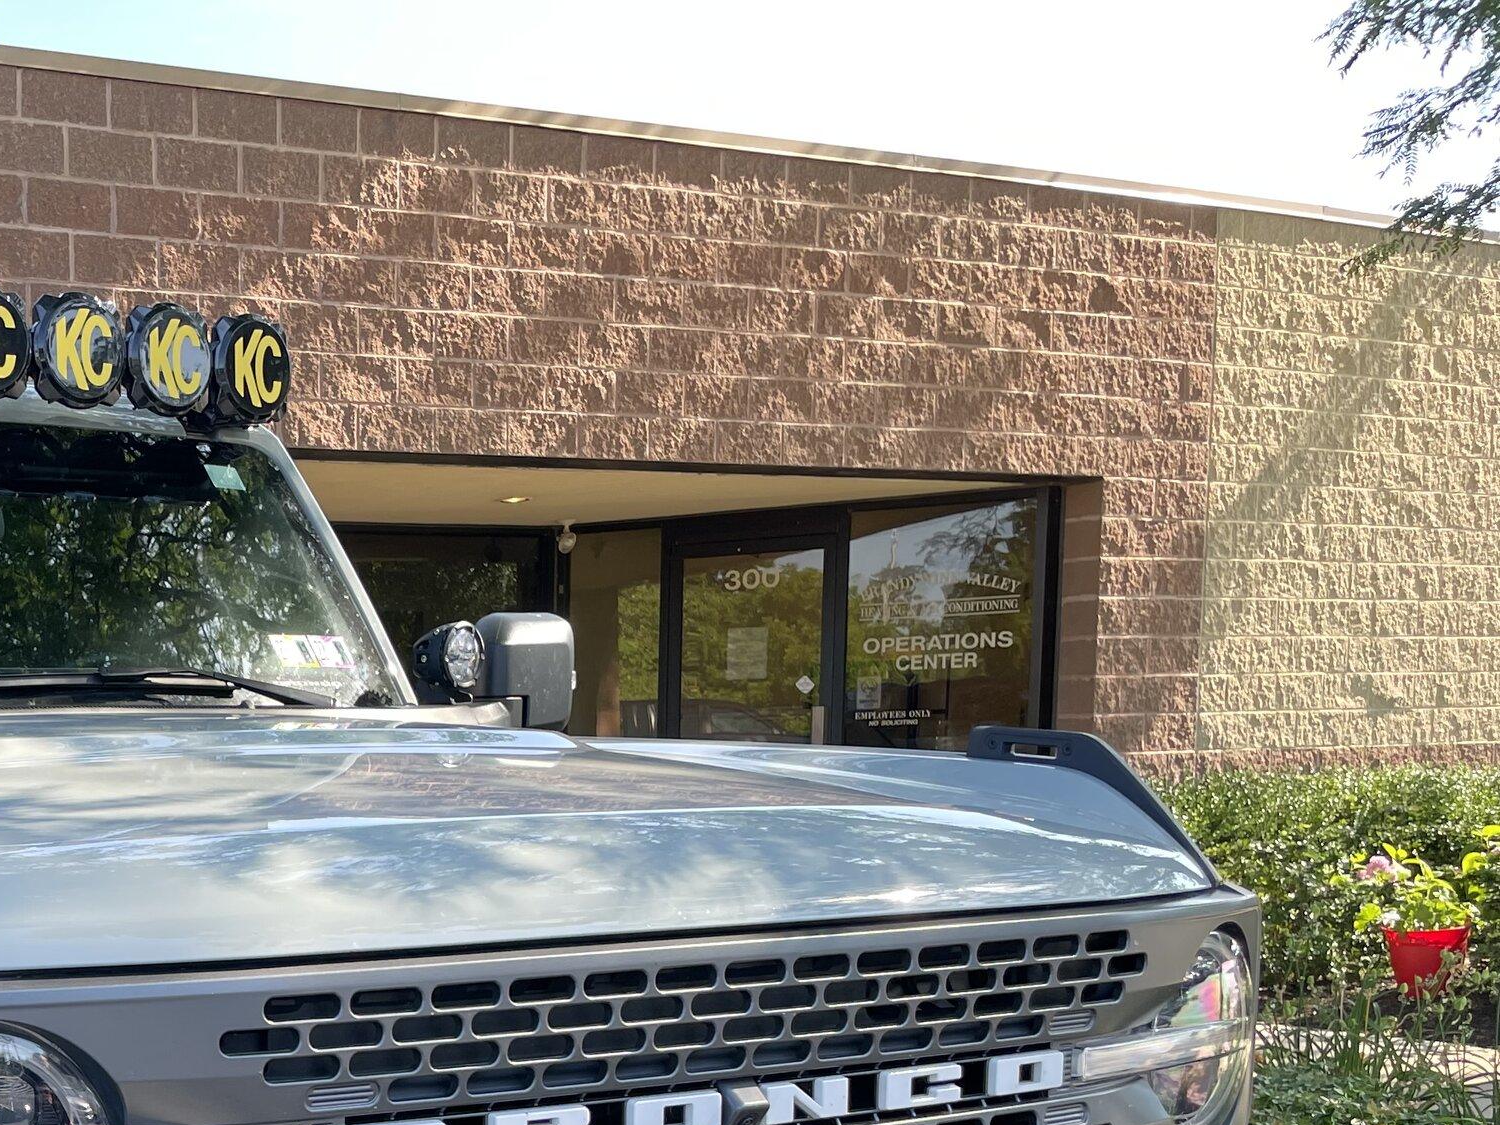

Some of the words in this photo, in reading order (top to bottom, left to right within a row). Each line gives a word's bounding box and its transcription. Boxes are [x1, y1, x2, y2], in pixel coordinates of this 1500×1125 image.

[55, 308, 113, 391] KC
[148, 318, 201, 400] KC
[234, 328, 283, 408] KC
[724, 567, 780, 591] 300
[863, 630, 1014, 654] OPERATIONS
[895, 651, 978, 672] CENTER
[854, 710, 907, 720] EMPLOYEES
[908, 709, 931, 718] ONLY
